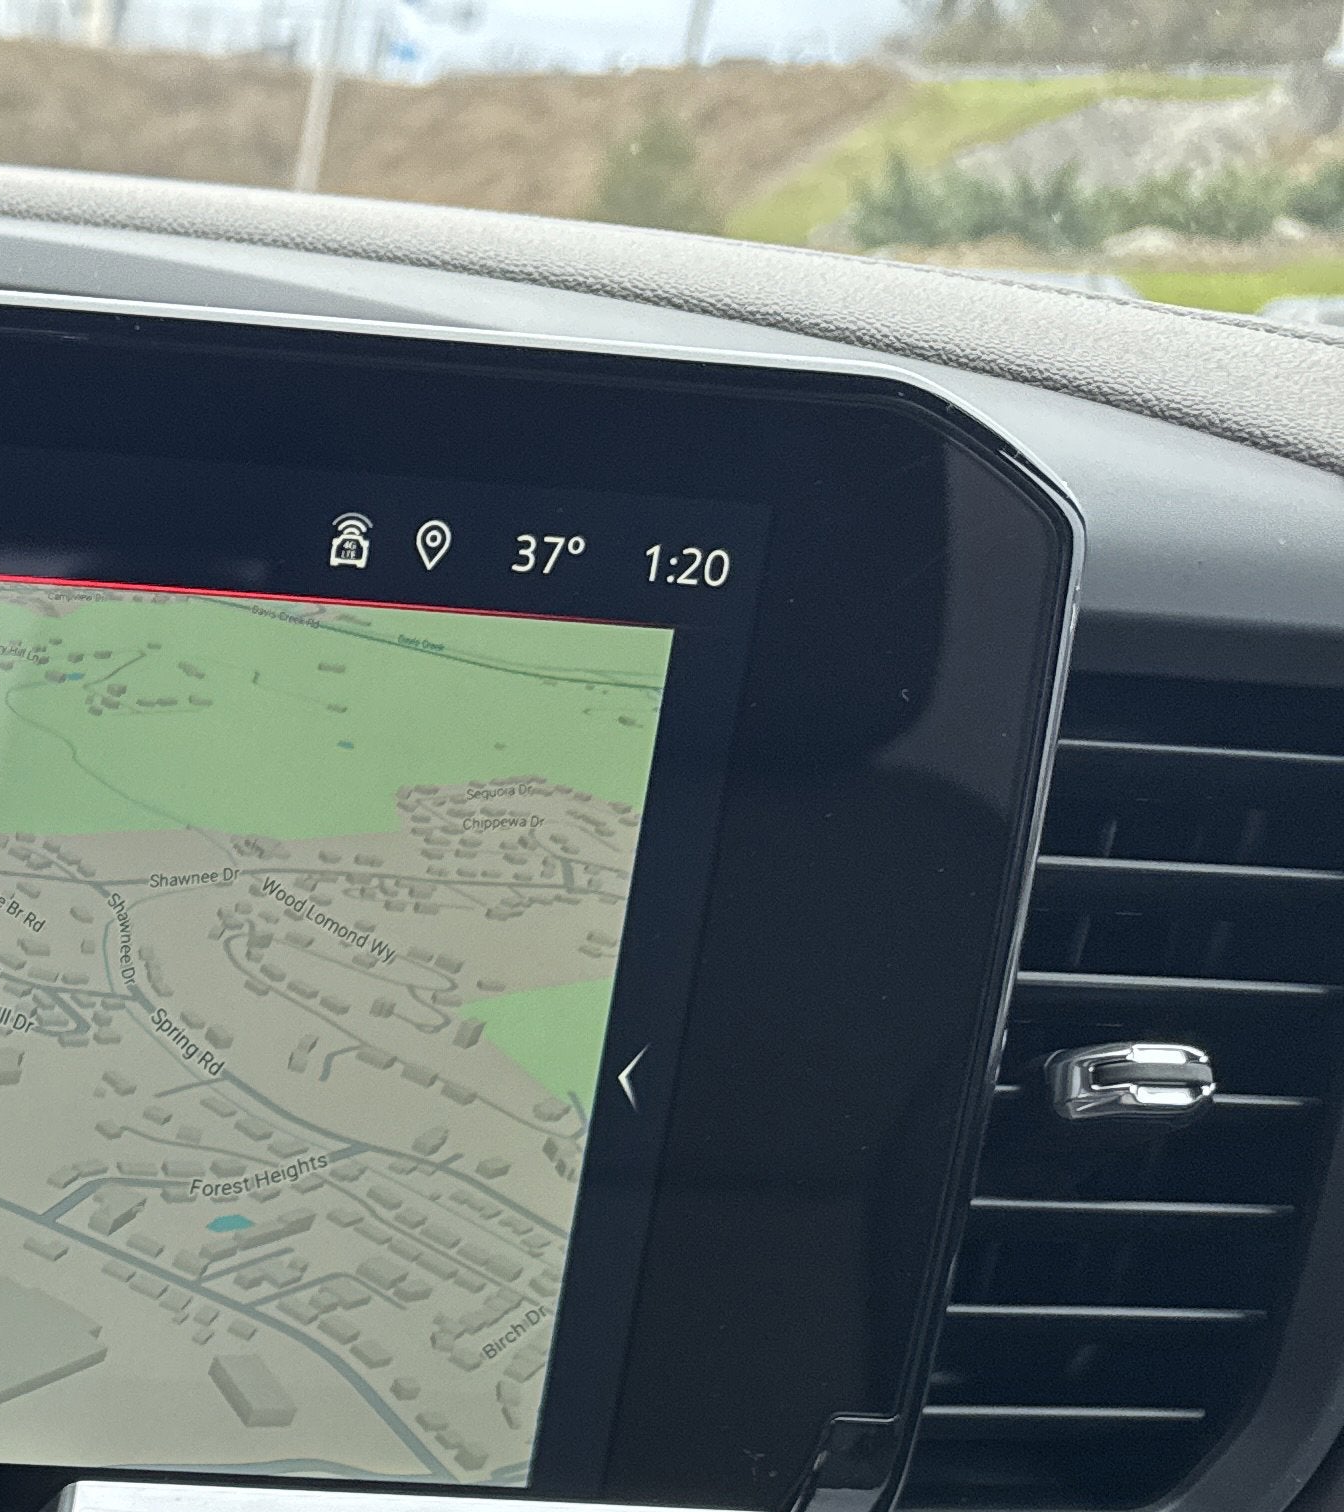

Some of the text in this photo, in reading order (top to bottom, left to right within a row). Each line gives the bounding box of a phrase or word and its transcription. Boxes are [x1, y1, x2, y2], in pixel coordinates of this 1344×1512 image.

[645, 543, 731, 586] 1:20
[27, 650, 40, 663] Ln
[466, 783, 533, 801] Sequoia Dr
[462, 815, 545, 833] Chippewa Dr
[149, 866, 240, 889] Shawnee Dr
[6, 900, 23, 919] Br
[22, 912, 46, 934] Rd
[261, 876, 397, 965] Wood Lomond Wy
[107, 892, 136, 986] Shawnee Dr
[12, 1014, 35, 1034] Dr
[150, 1008, 225, 1078] Spring Rd
[189, 1155, 329, 1197] Forest Heights
[482, 1302, 548, 1360] Birch Dr
